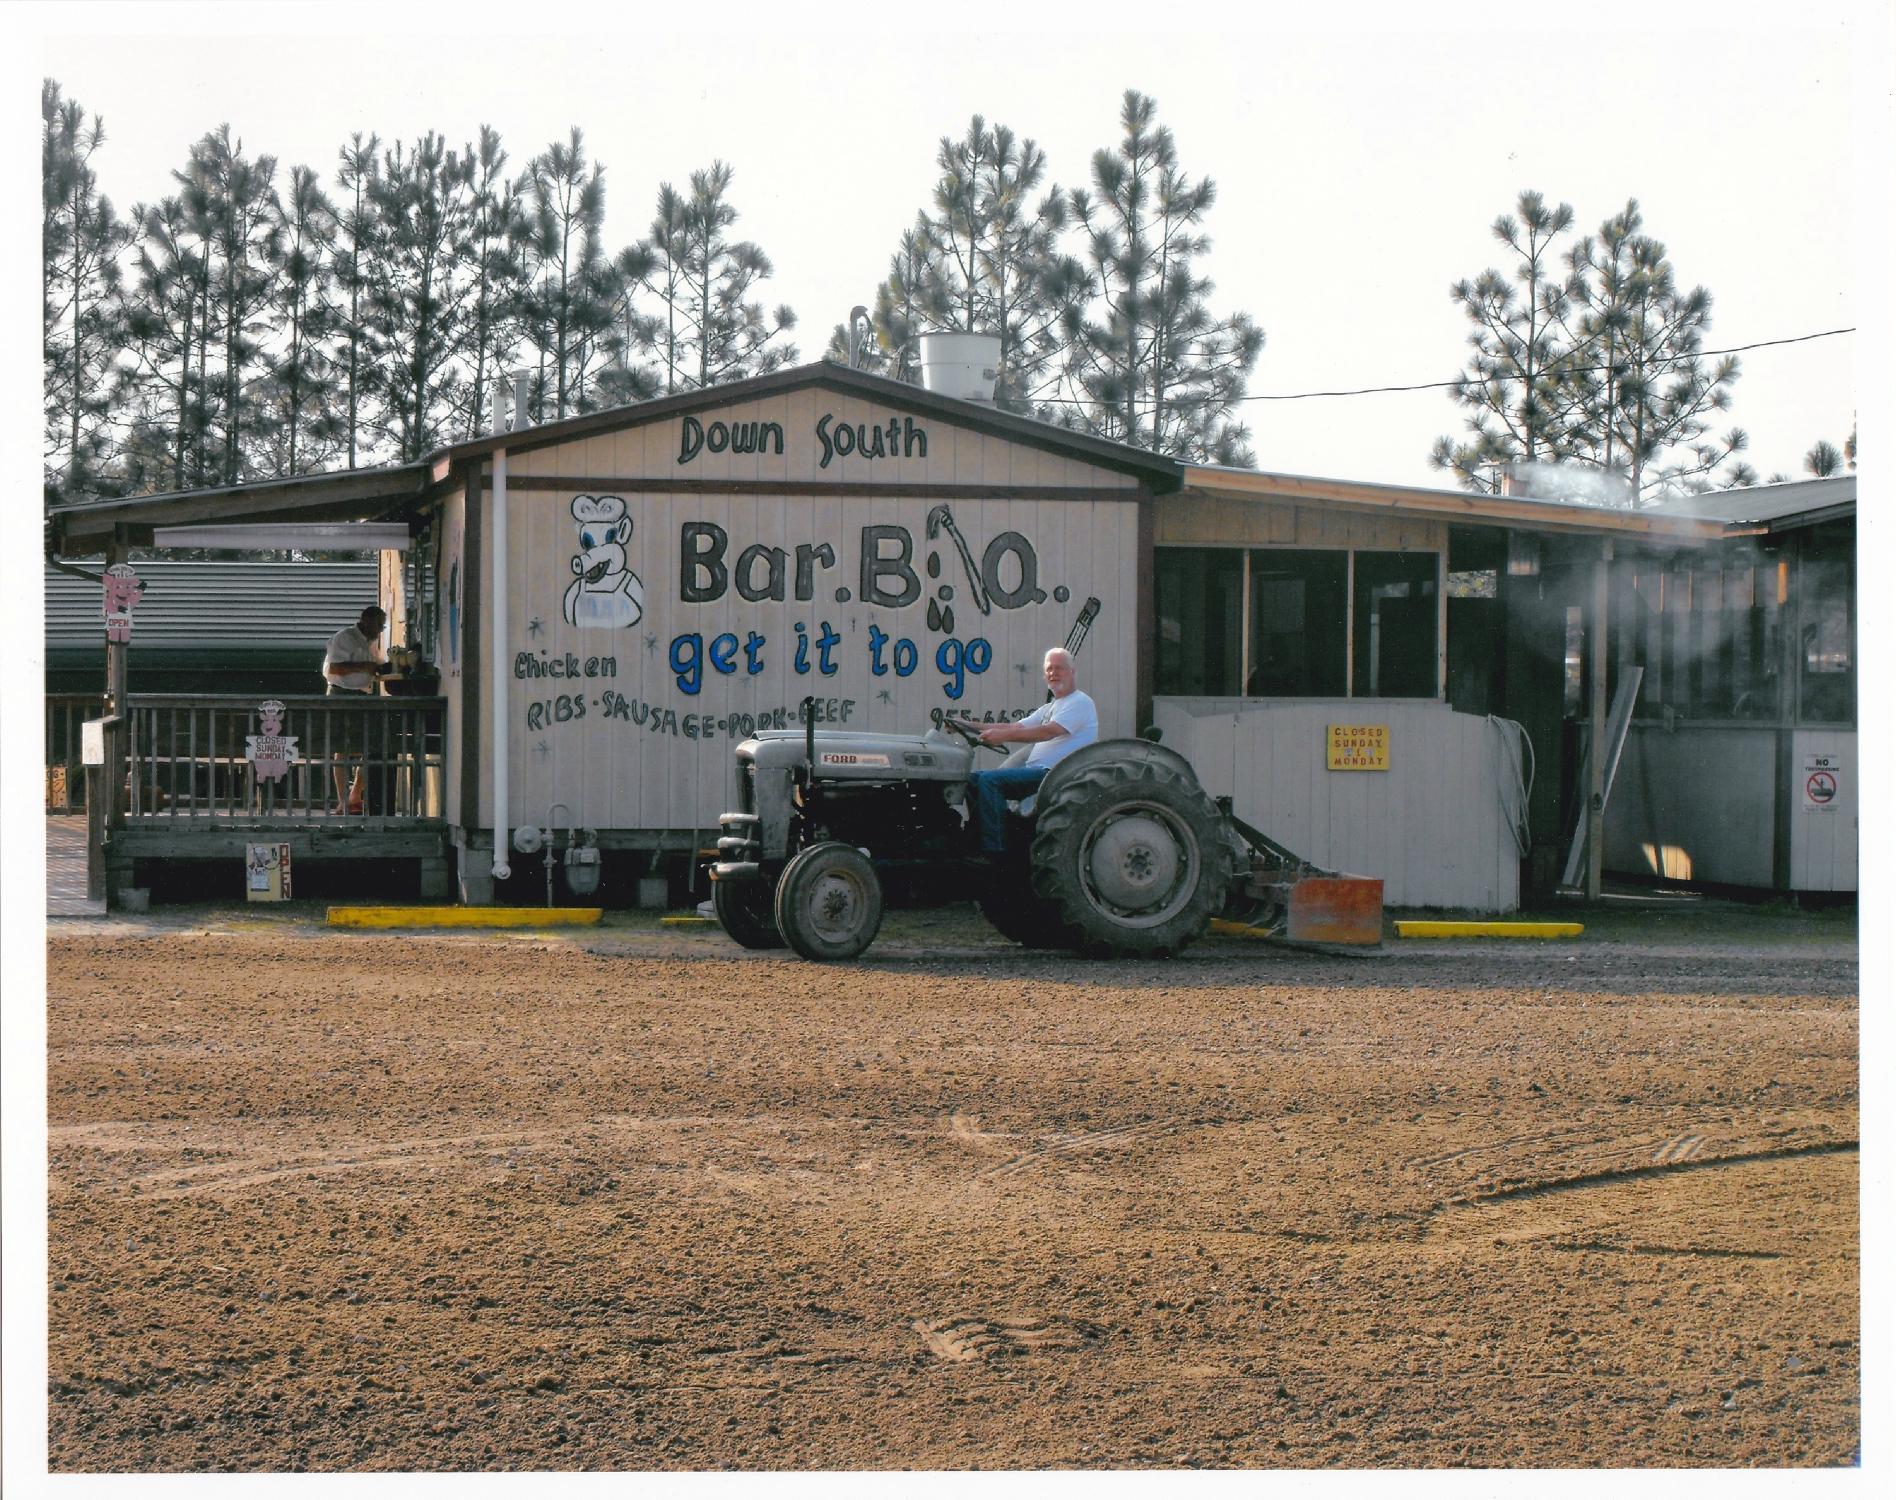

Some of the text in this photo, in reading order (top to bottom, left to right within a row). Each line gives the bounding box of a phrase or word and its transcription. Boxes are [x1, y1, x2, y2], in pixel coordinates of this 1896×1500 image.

[676, 413, 927, 469] Down South
[108, 618, 129, 627] OPEN
[514, 649, 617, 679] Chicken
[669, 621, 993, 700] get it to go
[1334, 727, 1383, 737] CLOSED
[256, 737, 287, 745] CLOSED
[1334, 738, 1383, 748] SUNDAY
[256, 745, 285, 753] SUNDAY
[823, 754, 857, 764] FORD
[1334, 757, 1384, 766] MONDAY
[1815, 758, 1829, 766] NO
[279, 844, 291, 899] OPEN
